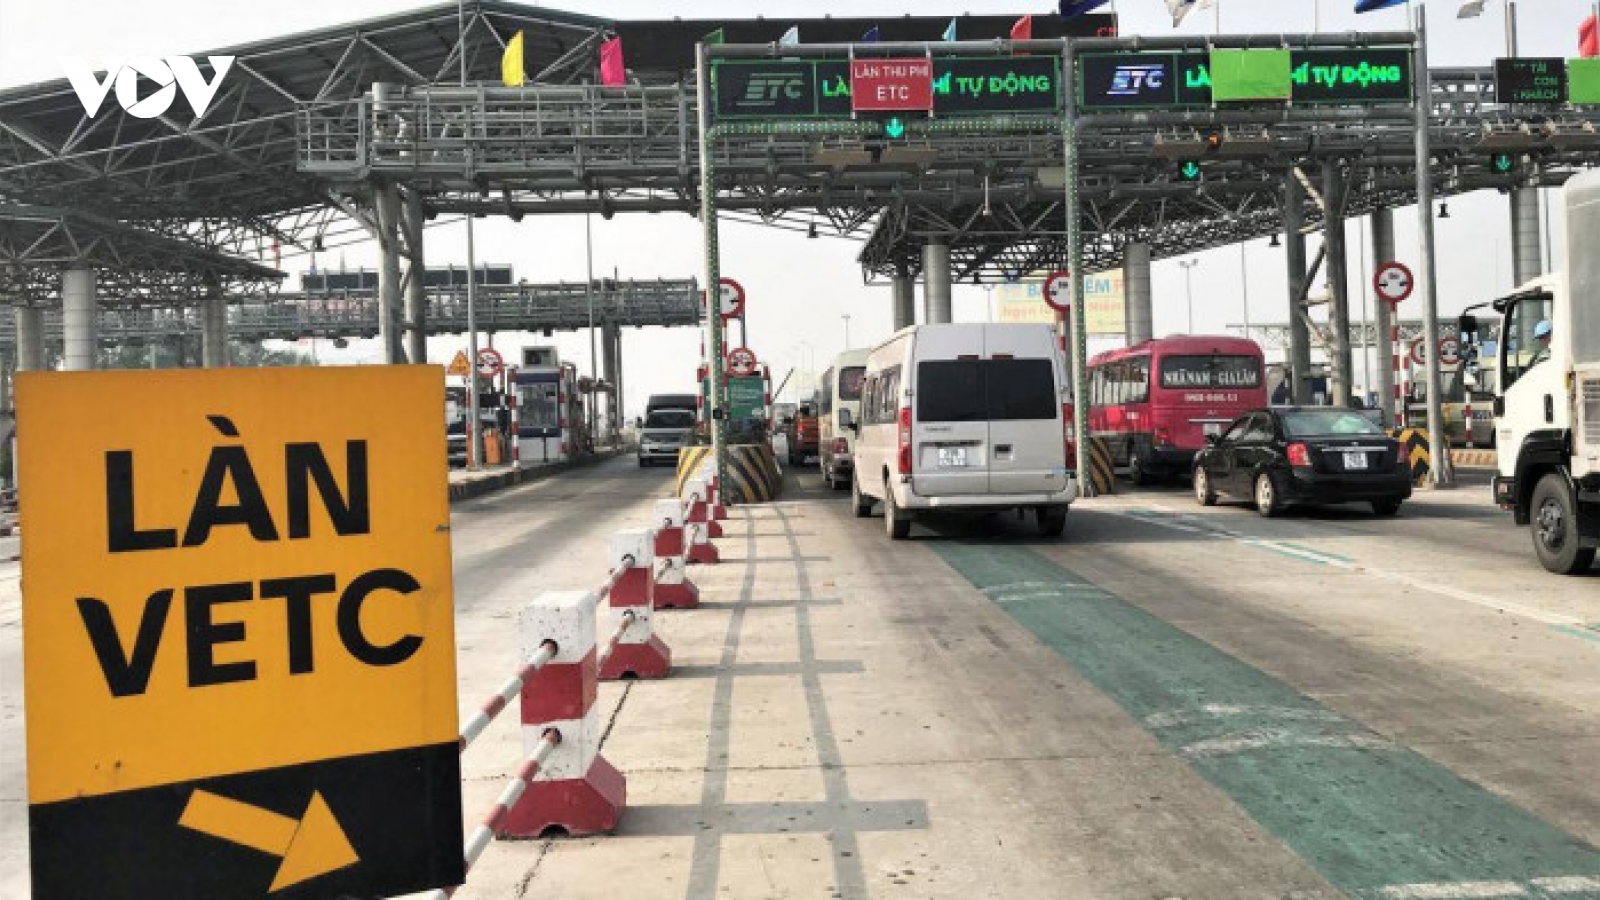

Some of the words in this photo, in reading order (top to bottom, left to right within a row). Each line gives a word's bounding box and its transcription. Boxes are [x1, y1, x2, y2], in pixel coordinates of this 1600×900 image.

[854, 64, 879, 79] LÀN
[881, 65, 906, 77] THU
[1110, 68, 1164, 91] ETC
[1186, 63, 1213, 88] LÀ
[1312, 65, 1340, 88] TỰ
[1342, 61, 1400, 88] ĐỘNG
[743, 77, 805, 101] ETC
[822, 75, 852, 97] LÀ
[932, 71, 952, 94] HÍ
[956, 76, 984, 98] TỰ
[989, 71, 1050, 97] ĐỘNG
[877, 85, 909, 101] ETC
[104, 413, 371, 553] LÀN
[75, 567, 425, 699] VETC
